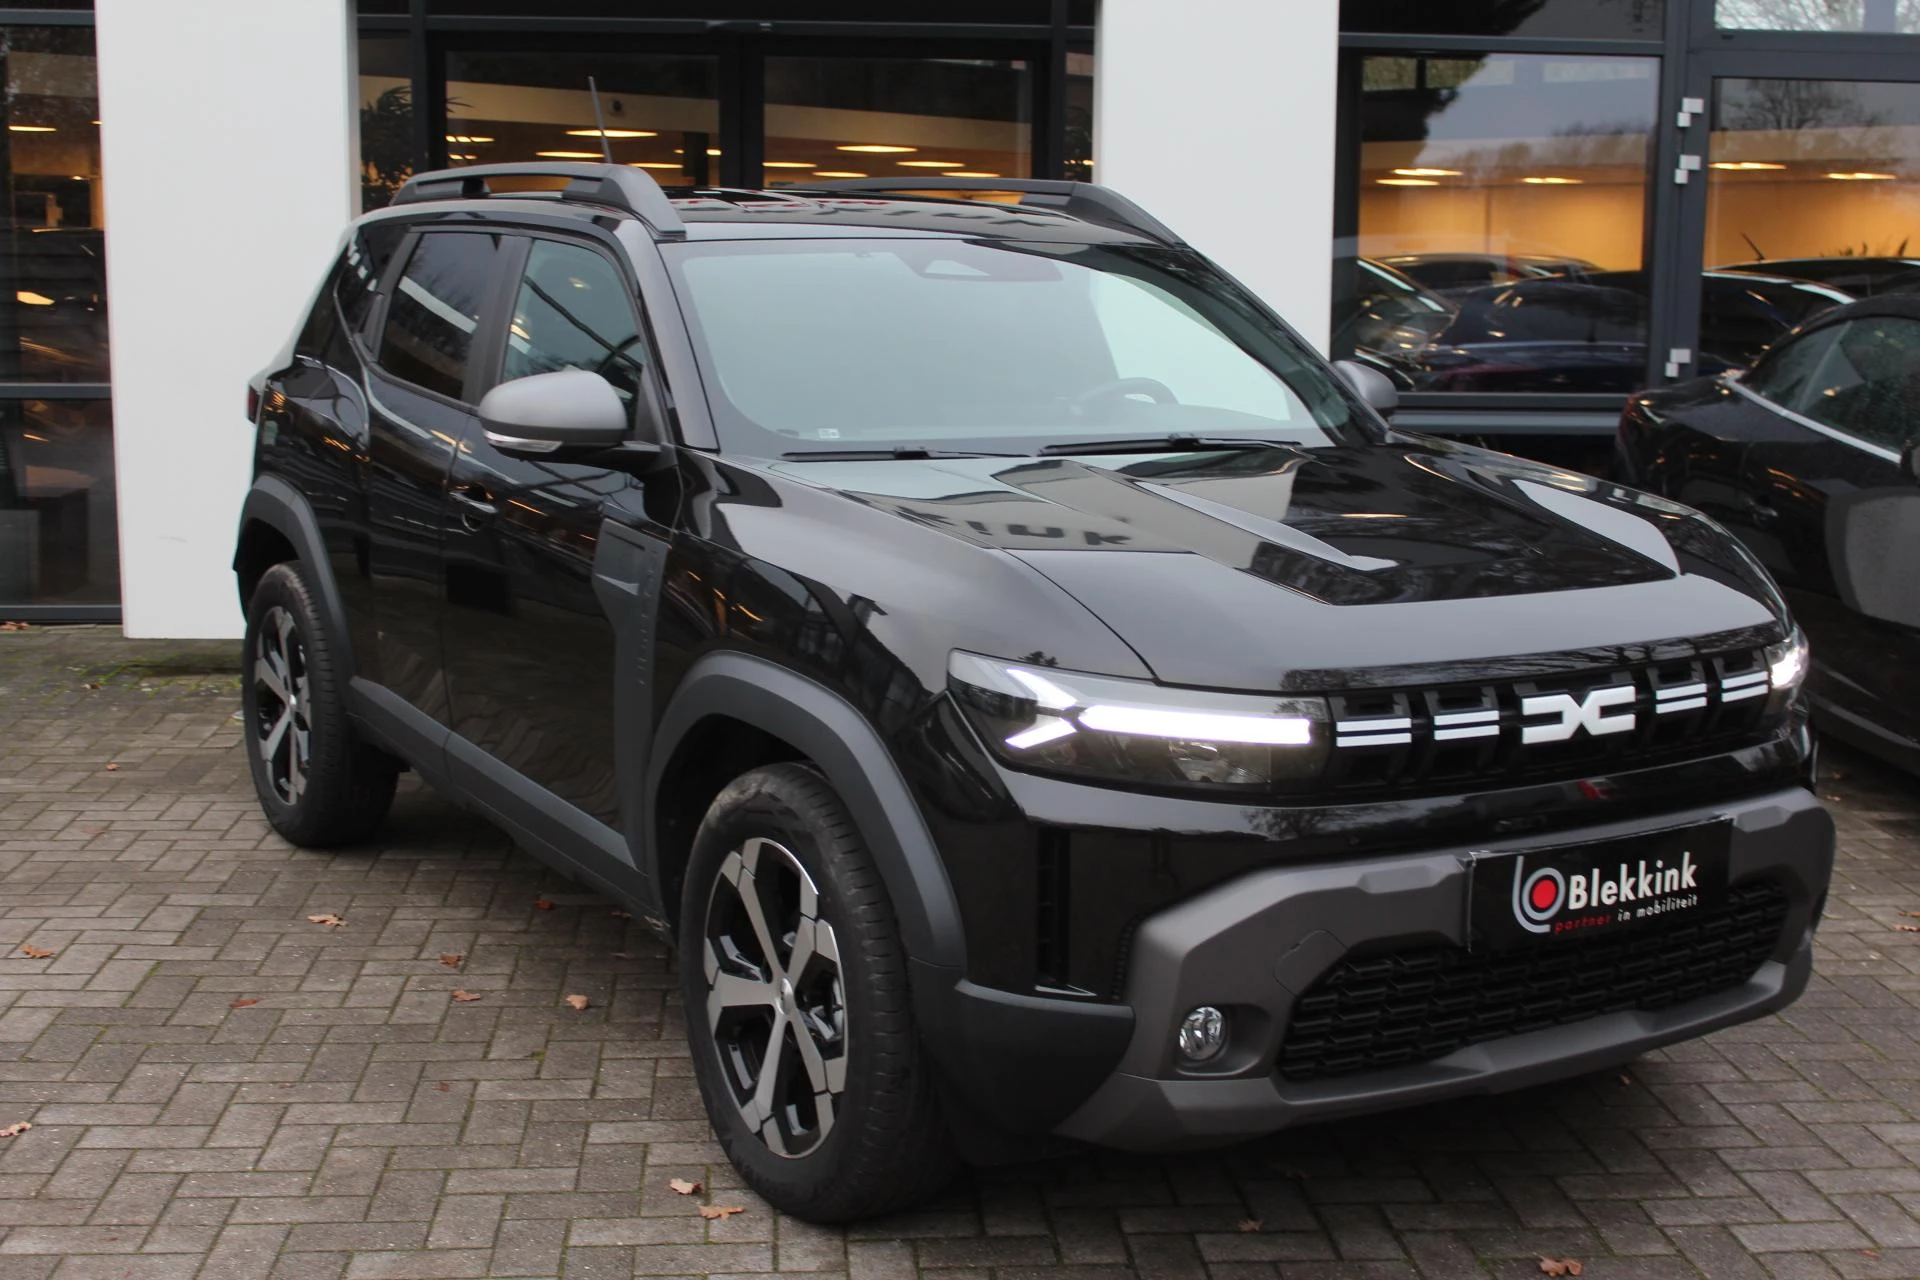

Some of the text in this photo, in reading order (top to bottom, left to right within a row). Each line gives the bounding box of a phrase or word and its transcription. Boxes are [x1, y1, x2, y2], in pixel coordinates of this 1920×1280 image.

[1568, 851, 1698, 910] Blekkink
[1554, 894, 1698, 934] partner in mobiliteit
